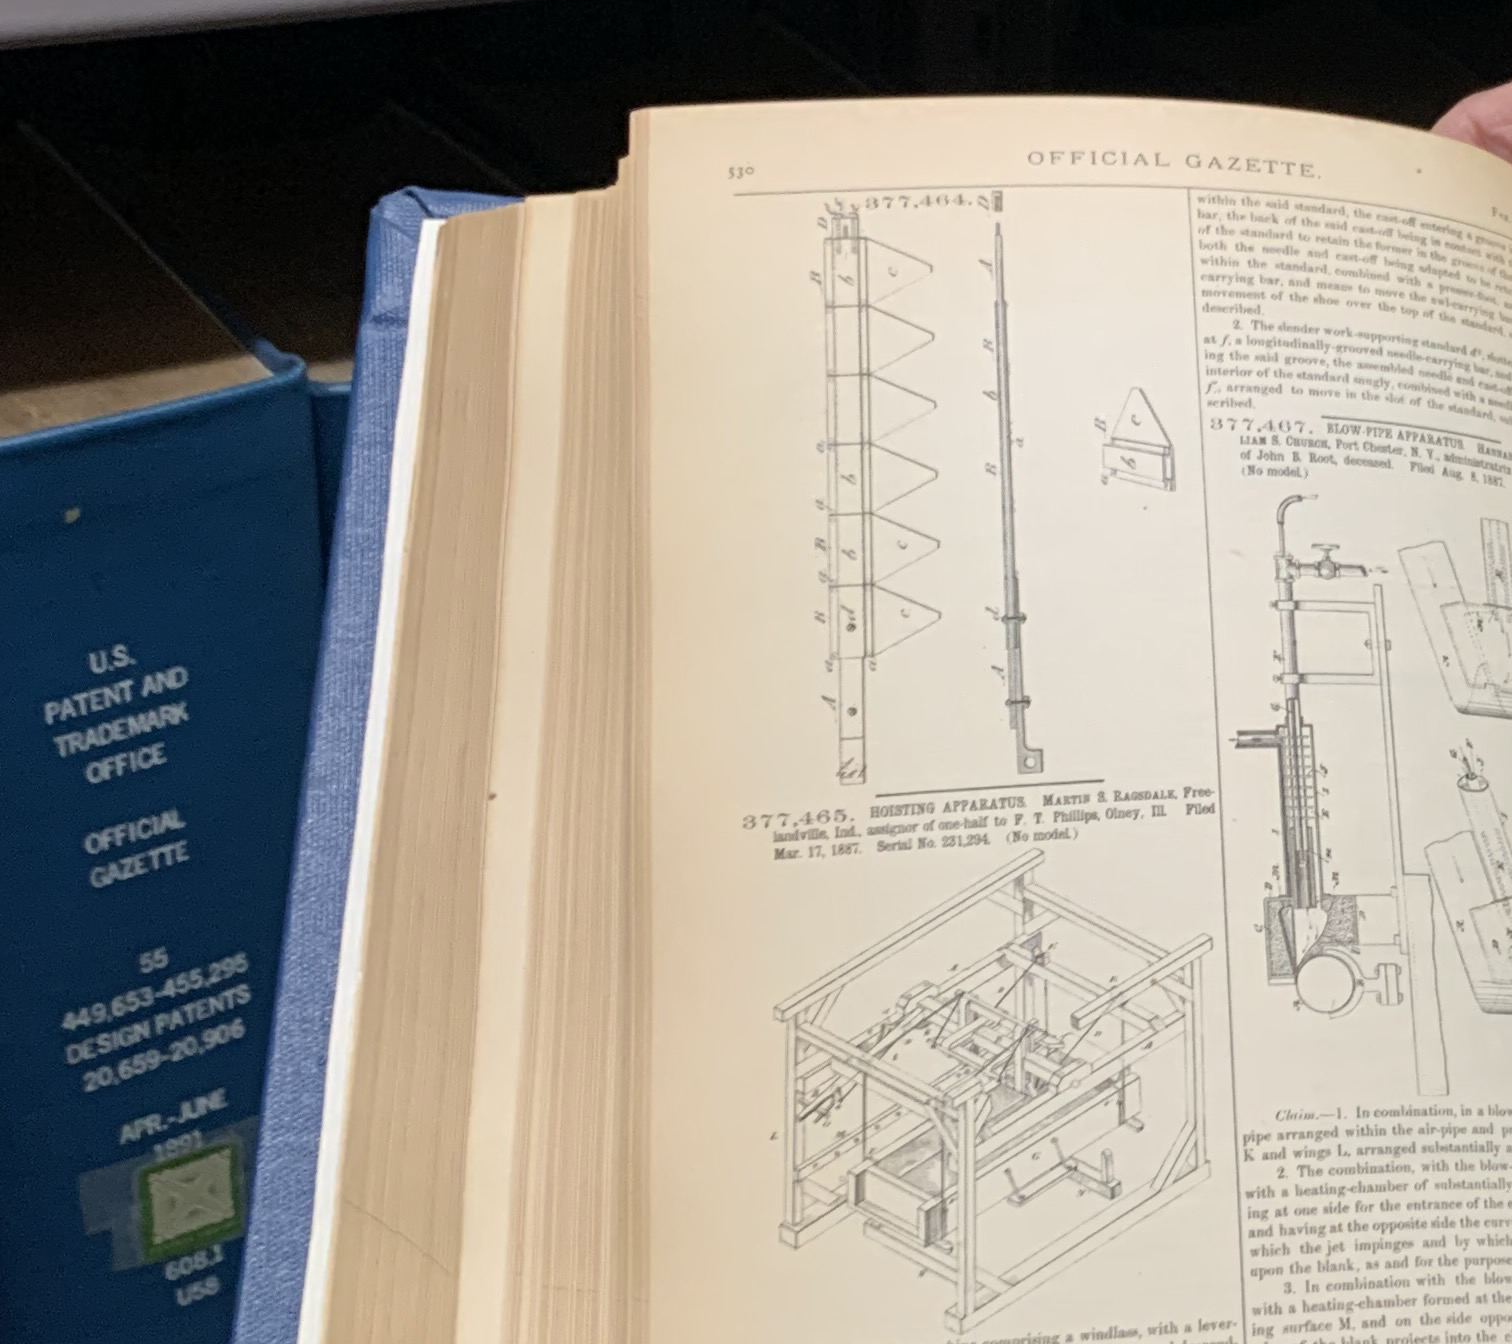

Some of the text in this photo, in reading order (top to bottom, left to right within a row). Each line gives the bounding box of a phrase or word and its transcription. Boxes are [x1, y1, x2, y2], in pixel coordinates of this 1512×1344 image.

[1027, 151, 1322, 180] OFFICIAL GAZETTE.
[88, 644, 137, 674] U.S.
[44, 665, 188, 725] PATENT AND
[54, 701, 189, 756] TRADEMARK
[85, 742, 167, 783] OFFICE
[84, 808, 186, 854] OFFICIAL
[870, 802, 935, 818] HOISTING
[90, 840, 189, 888] GAZETTE
[139, 947, 169, 973] 55
[66, 984, 251, 1064] DESIGN PATENTS
